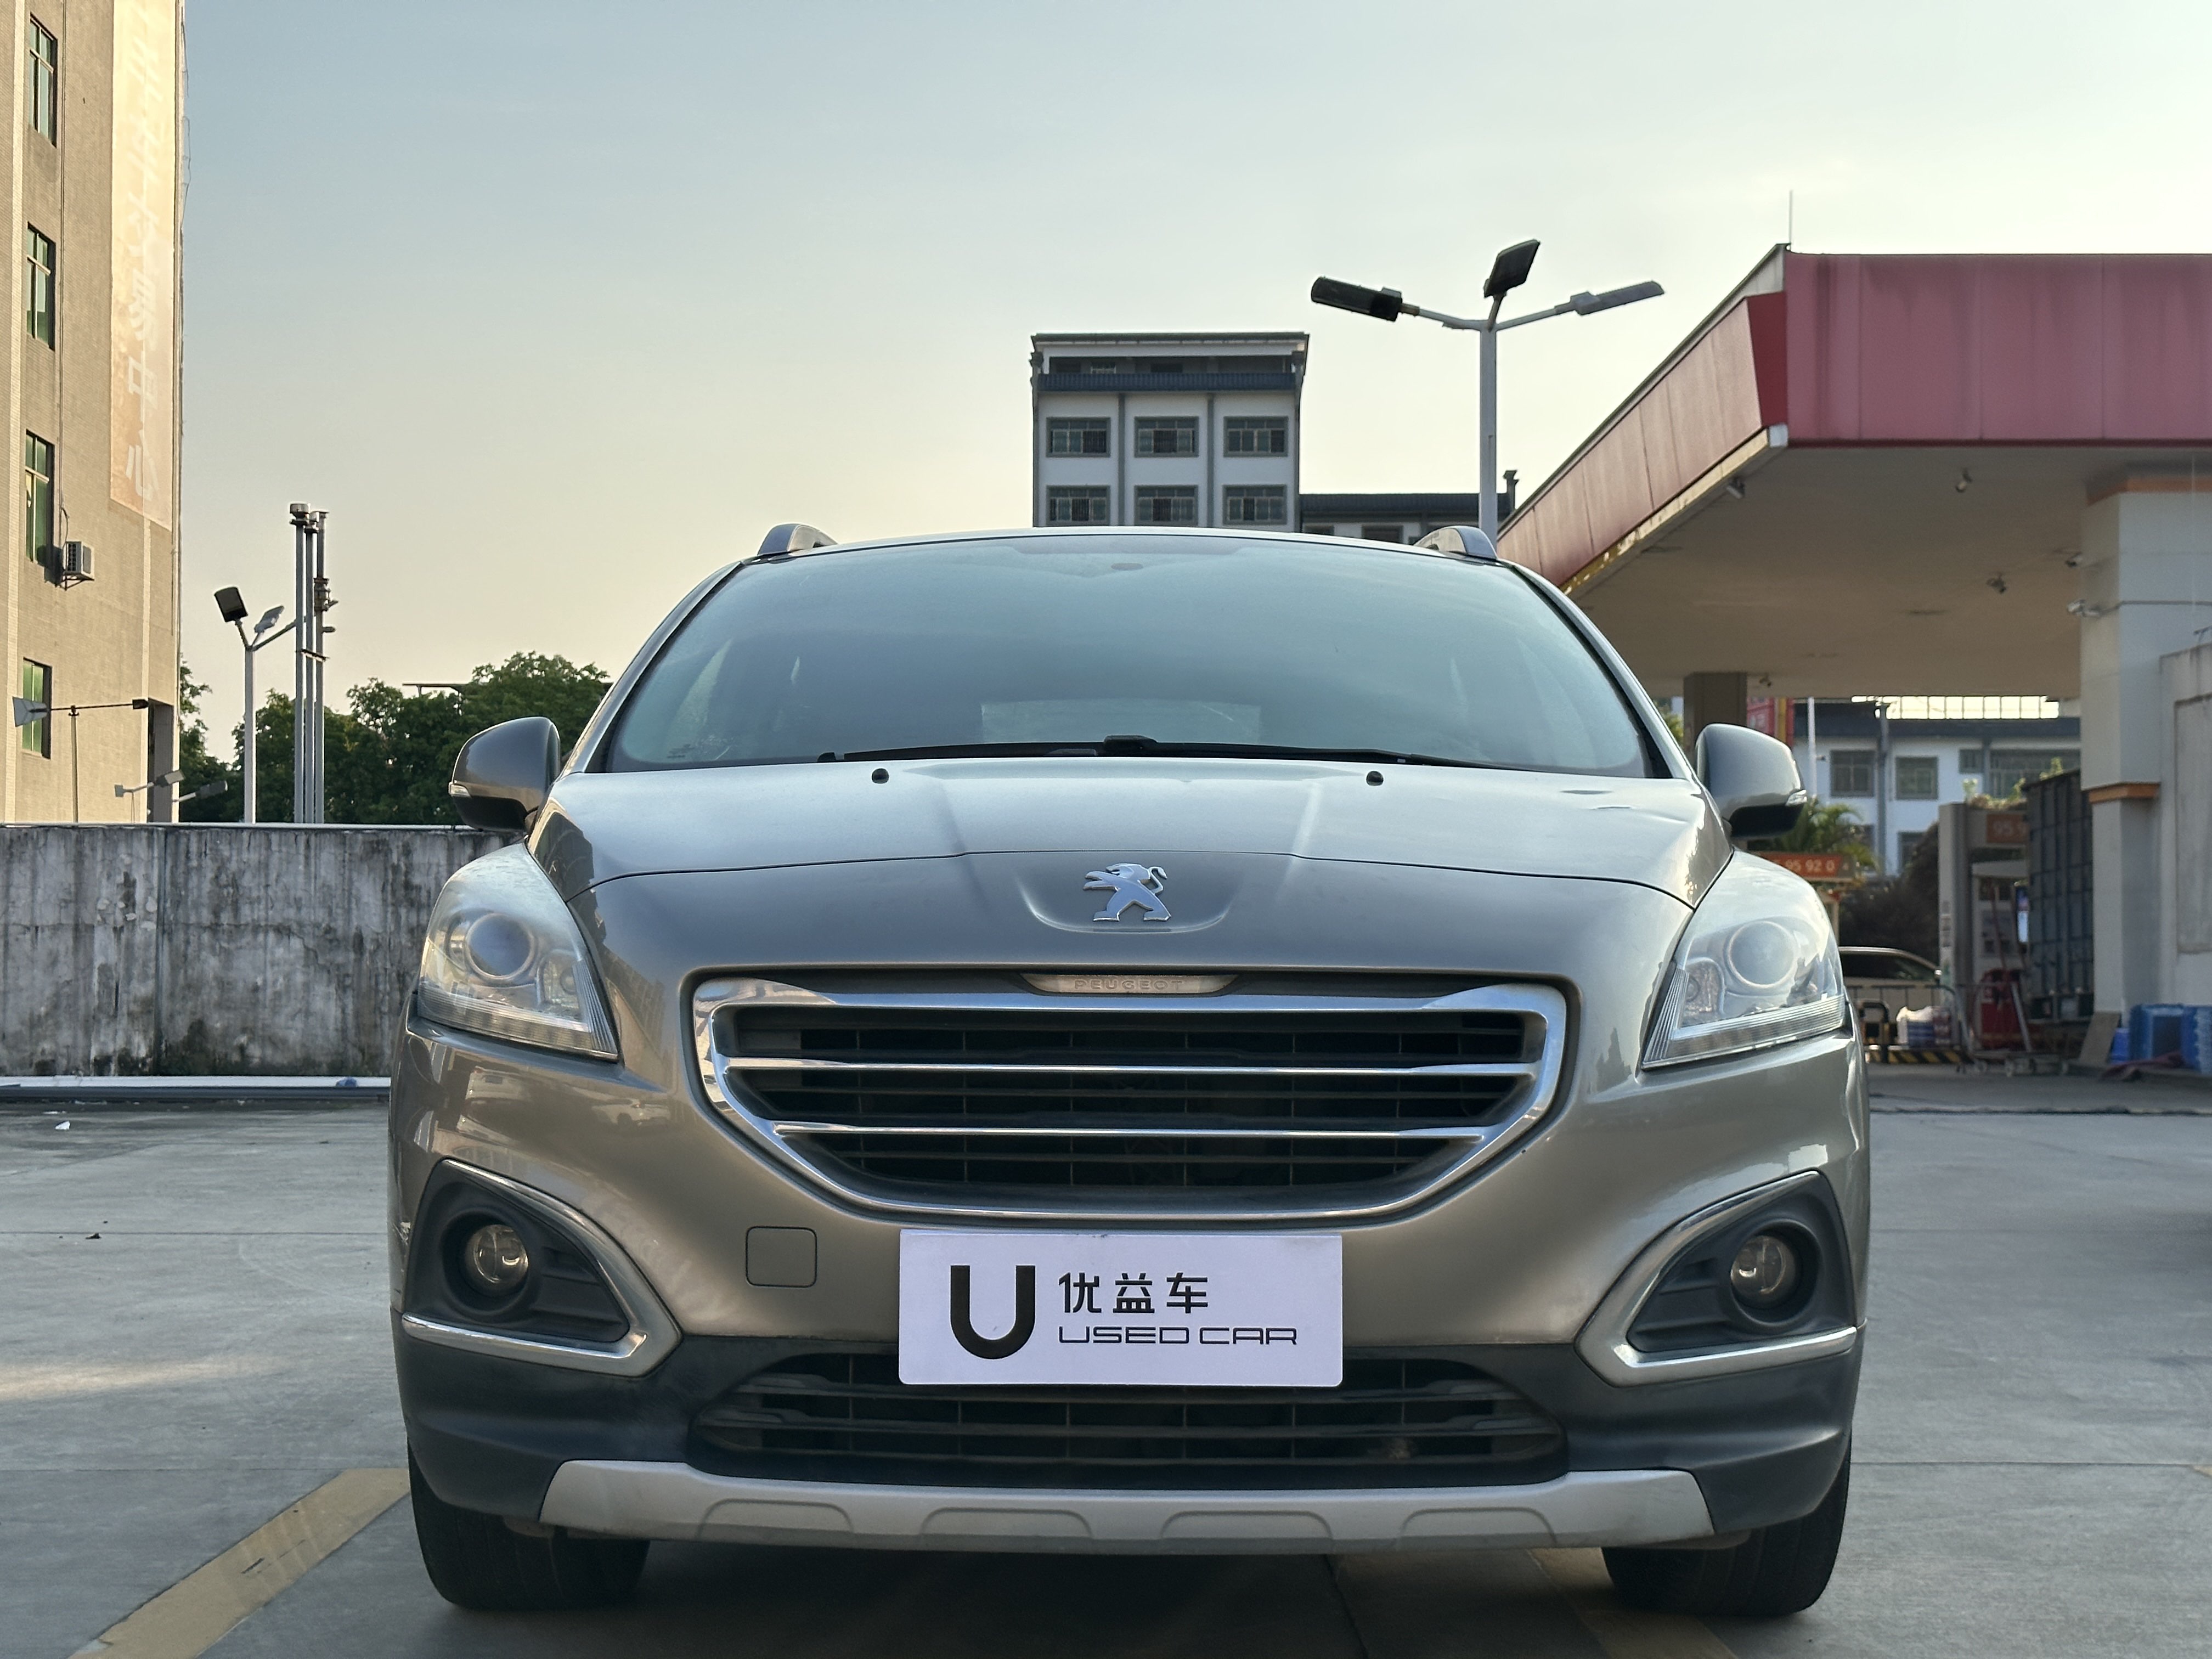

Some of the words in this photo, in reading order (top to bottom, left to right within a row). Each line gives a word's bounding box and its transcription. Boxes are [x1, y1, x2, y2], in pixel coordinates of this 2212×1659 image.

[1074, 979, 1184, 991] PEUGEOT
[1059, 1272, 1209, 1314] 优益车
[950, 1265, 1036, 1359] U
[1059, 1325, 1189, 1345] USED
[1199, 1327, 1297, 1346] CAR
